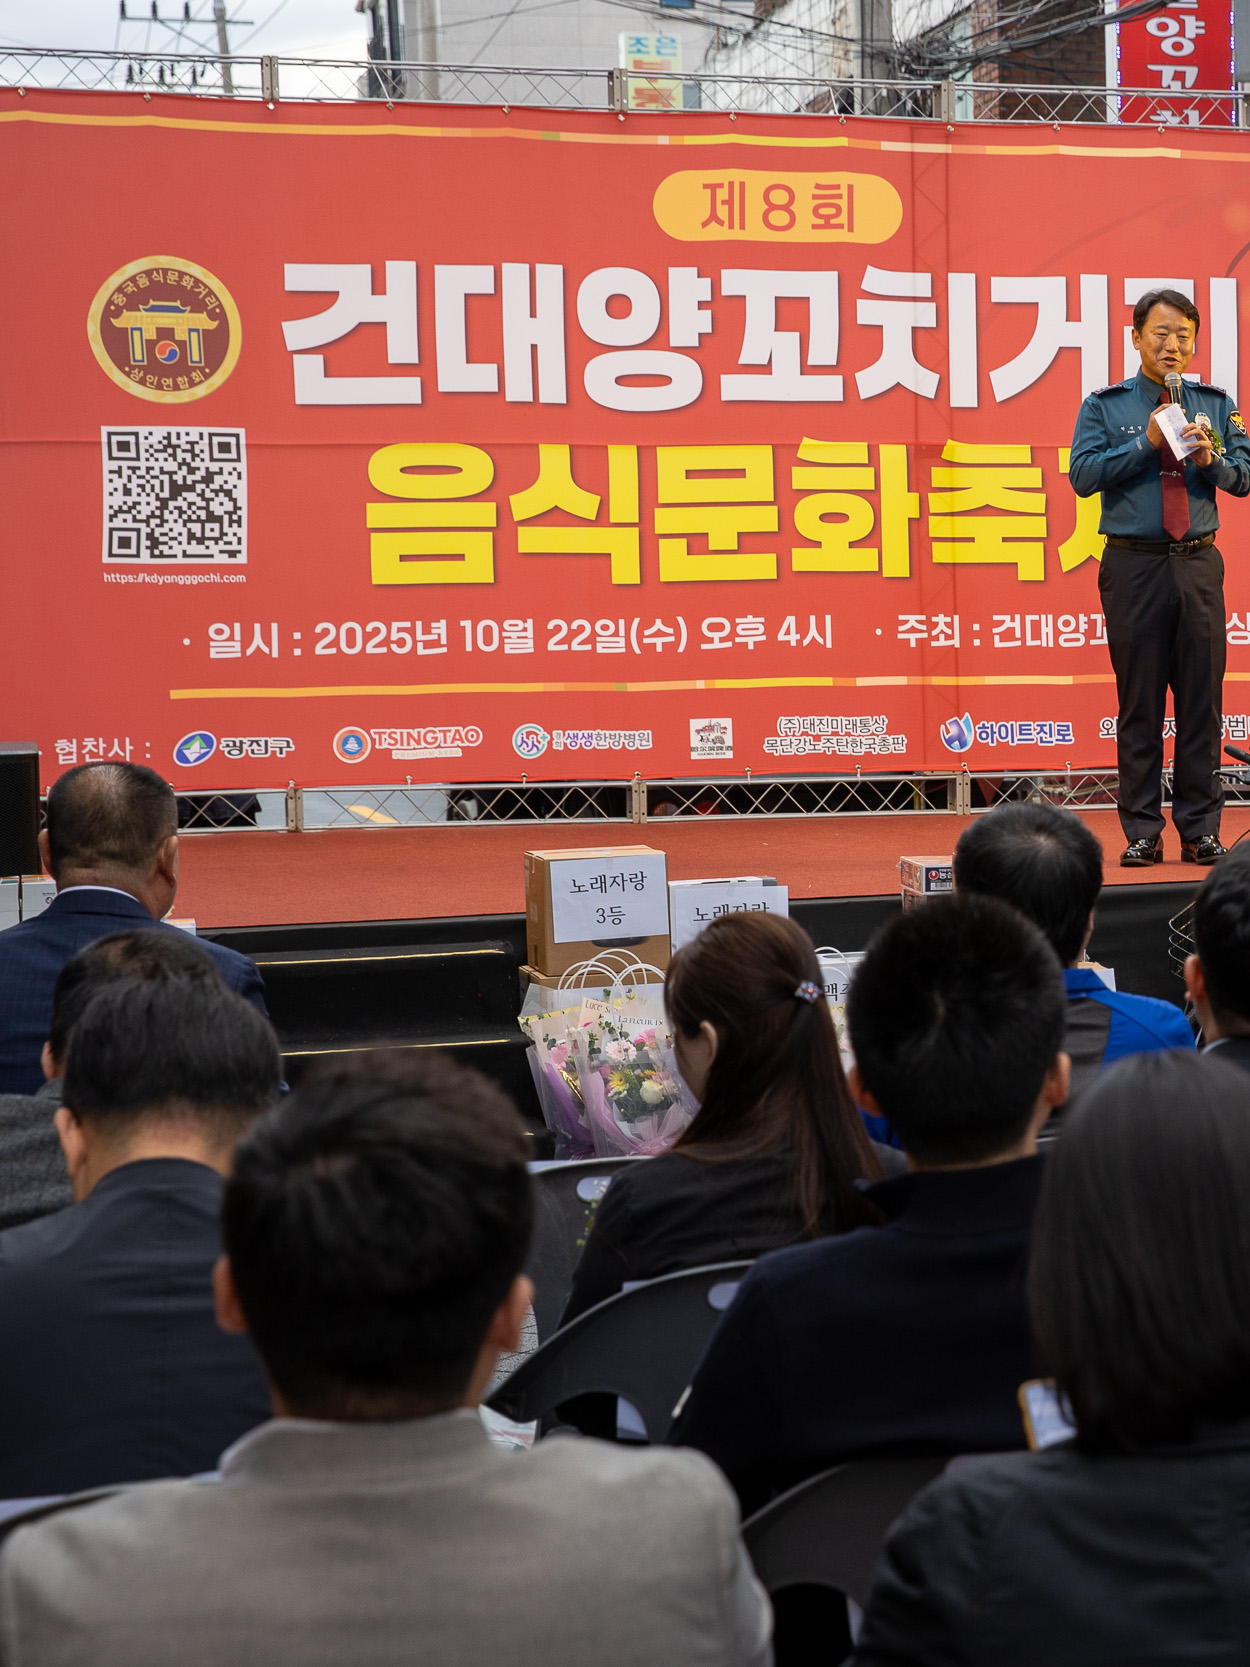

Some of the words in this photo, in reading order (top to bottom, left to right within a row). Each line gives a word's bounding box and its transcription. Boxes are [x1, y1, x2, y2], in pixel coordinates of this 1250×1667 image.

[627, 36, 677, 57] 조은
[1144, 0, 1206, 125] 양꼬치
[700, 180, 856, 233] 제8회
[111, 269, 220, 310] 중국음식문화거리
[130, 367, 206, 391] 상인연합회
[103, 571, 246, 586] https://kdyangggochi.com
[207, 622, 279, 659] 일시
[314, 619, 448, 656] 2025년
[460, 618, 535, 655] 10월
[547, 616, 688, 655] 22일(수)
[700, 614, 767, 650] 오후
[776, 613, 833, 649] 4시
[897, 613, 961, 649] 주최
[779, 717, 887, 735] (주)대진미래통상
[978, 722, 1074, 745] 하이트진로
[220, 738, 295, 758] 광진구
[373, 728, 481, 748] TSINGTAO
[565, 730, 651, 748] 생생한방병원
[765, 736, 905, 754] 목단강노주탄한국총판
[54, 736, 134, 765] 협찬사
[394, 749, 435, 758] PREMIUM
[438, 748, 460, 756] BEER
[569, 870, 648, 894] 노래자랑
[596, 905, 626, 926] 3등
